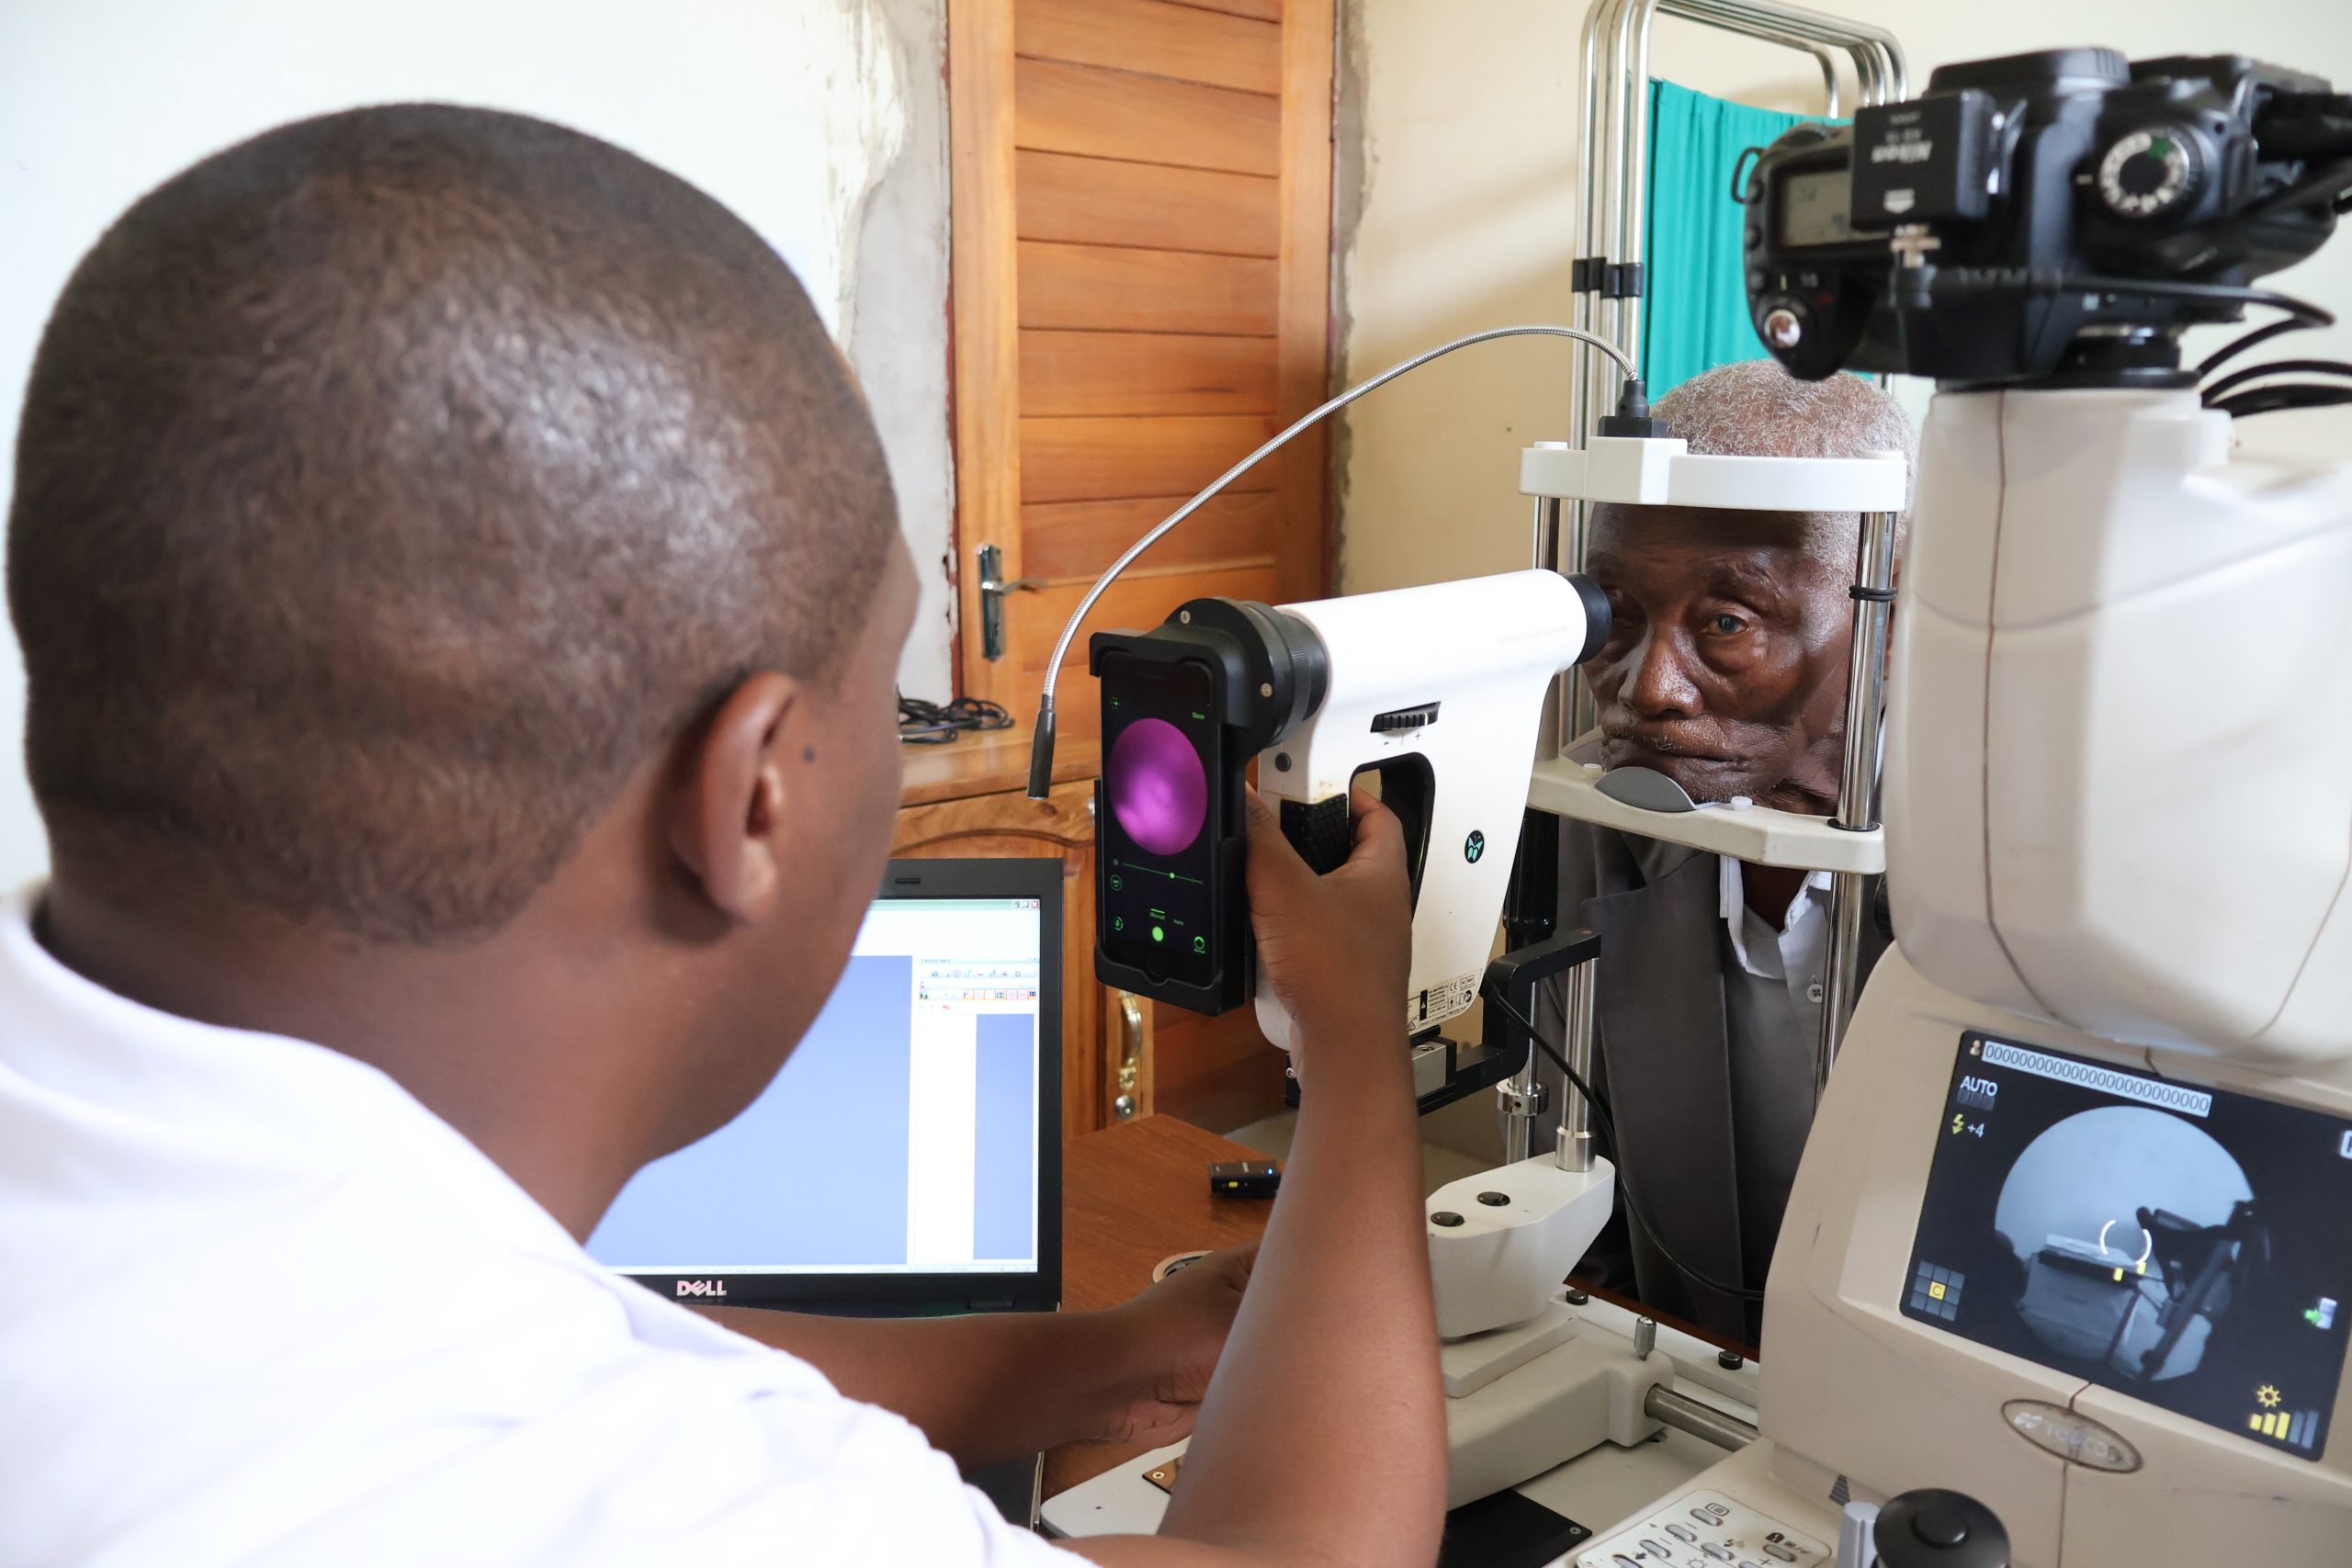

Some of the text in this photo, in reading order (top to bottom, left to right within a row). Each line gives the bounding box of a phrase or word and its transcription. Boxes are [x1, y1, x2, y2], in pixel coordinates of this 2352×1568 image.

[1960, 1076, 1998, 1097] AUTO
[1967, 1123, 1984, 1138] +4
[676, 1280, 728, 1296] DELL
[1932, 1285, 1943, 1296] C
[2047, 1425, 2124, 1464] TOCO
